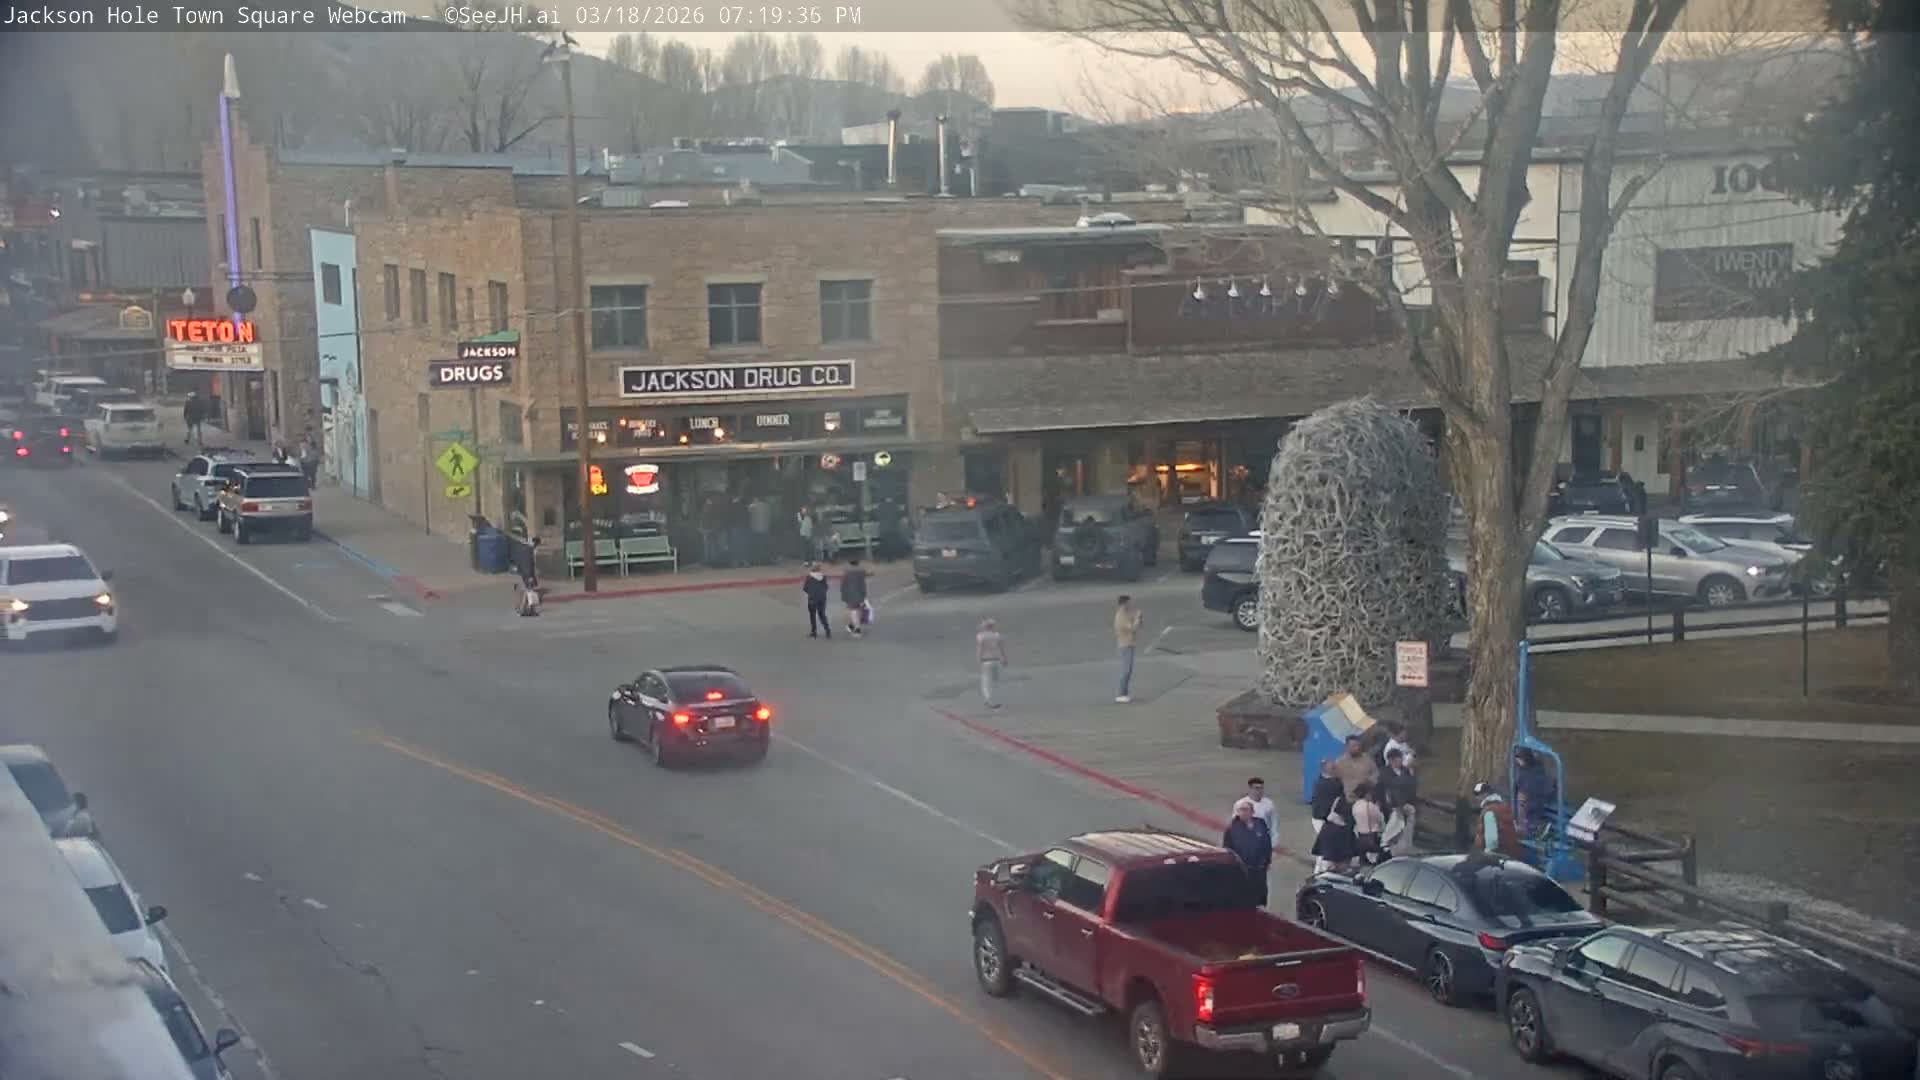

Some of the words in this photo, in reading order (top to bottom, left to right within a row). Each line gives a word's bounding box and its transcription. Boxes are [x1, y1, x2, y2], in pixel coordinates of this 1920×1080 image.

[171, 320, 253, 342] TETON
[463, 346, 516, 358] JACKSON
[440, 365, 504, 382] DRUGS
[631, 370, 735, 391] JACKSON
[744, 367, 801, 388] DRUG
[811, 366, 843, 385] CO.
[756, 413, 790, 427] DINNER
